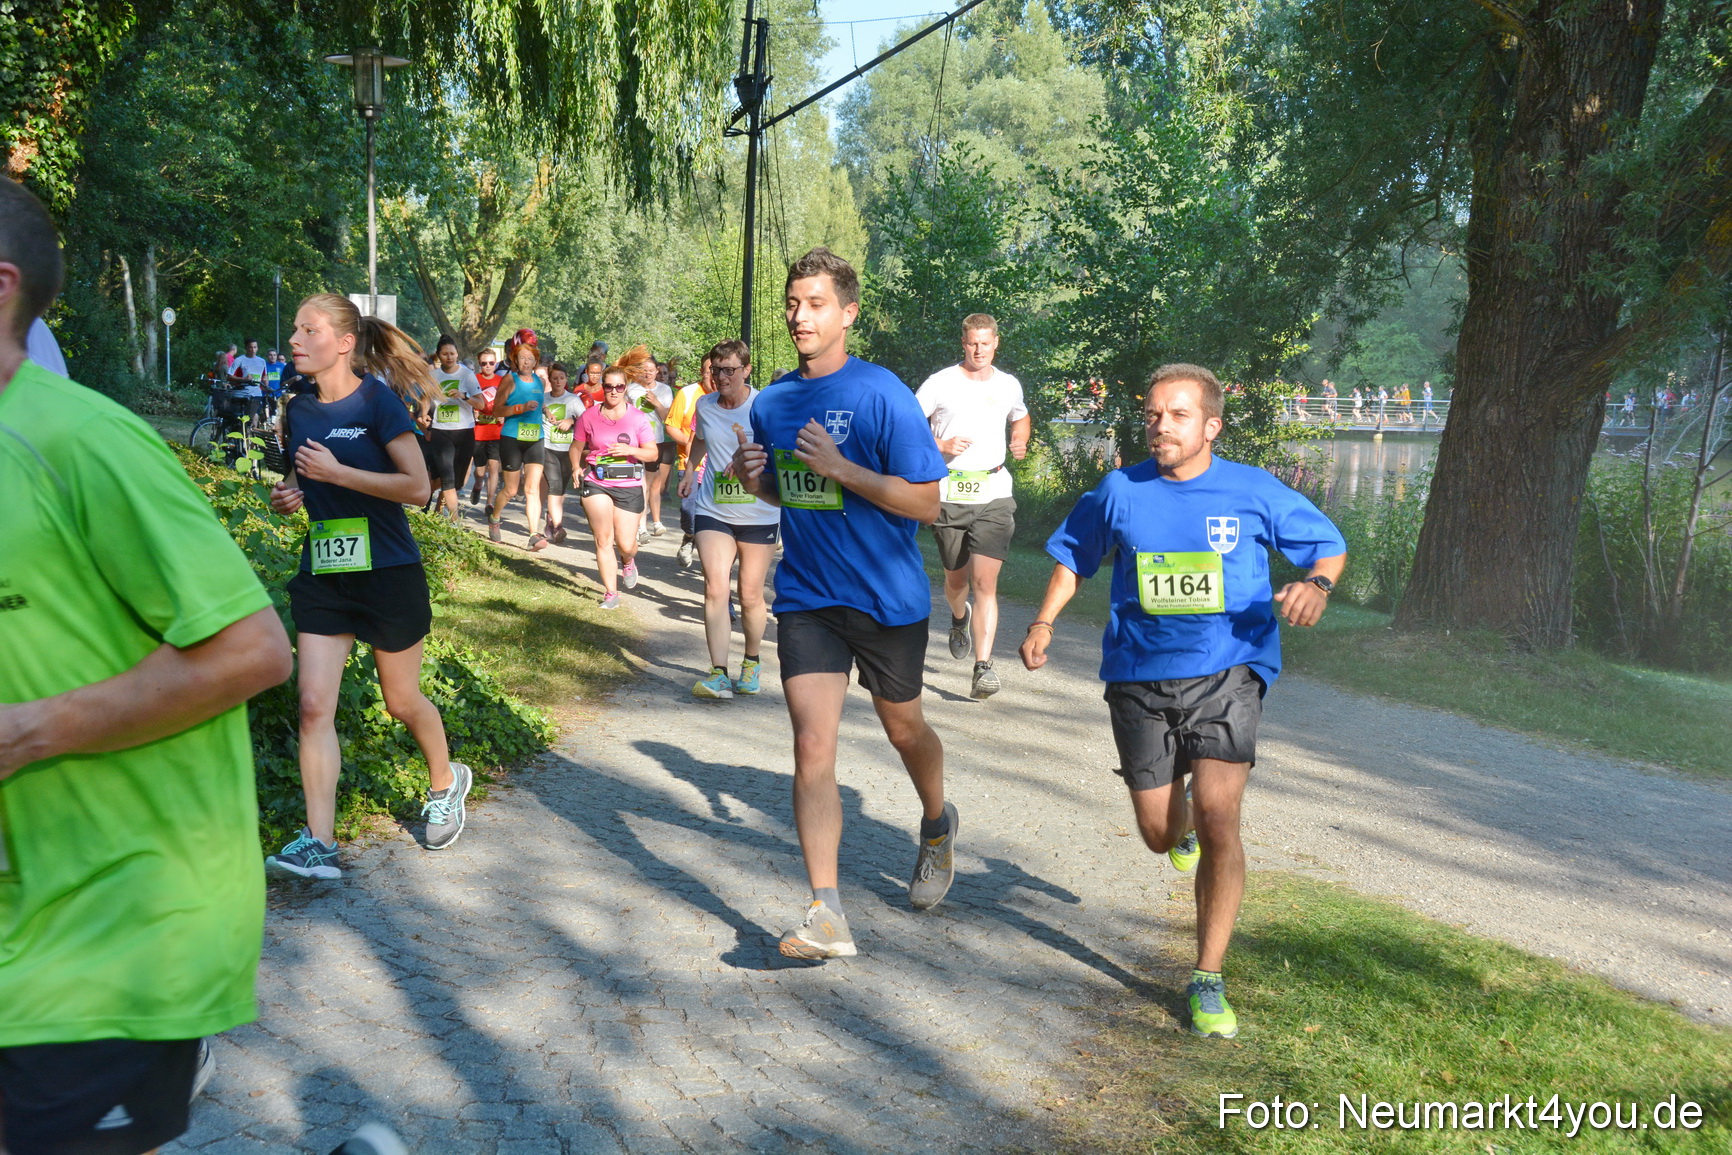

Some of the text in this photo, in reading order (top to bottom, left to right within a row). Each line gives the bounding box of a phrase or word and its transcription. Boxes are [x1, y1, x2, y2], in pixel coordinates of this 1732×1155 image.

[718, 483, 747, 495] 101
[783, 470, 828, 493] 1167
[957, 481, 980, 493] 992
[315, 537, 359, 559] 1137
[1149, 574, 1212, 597] 1164
